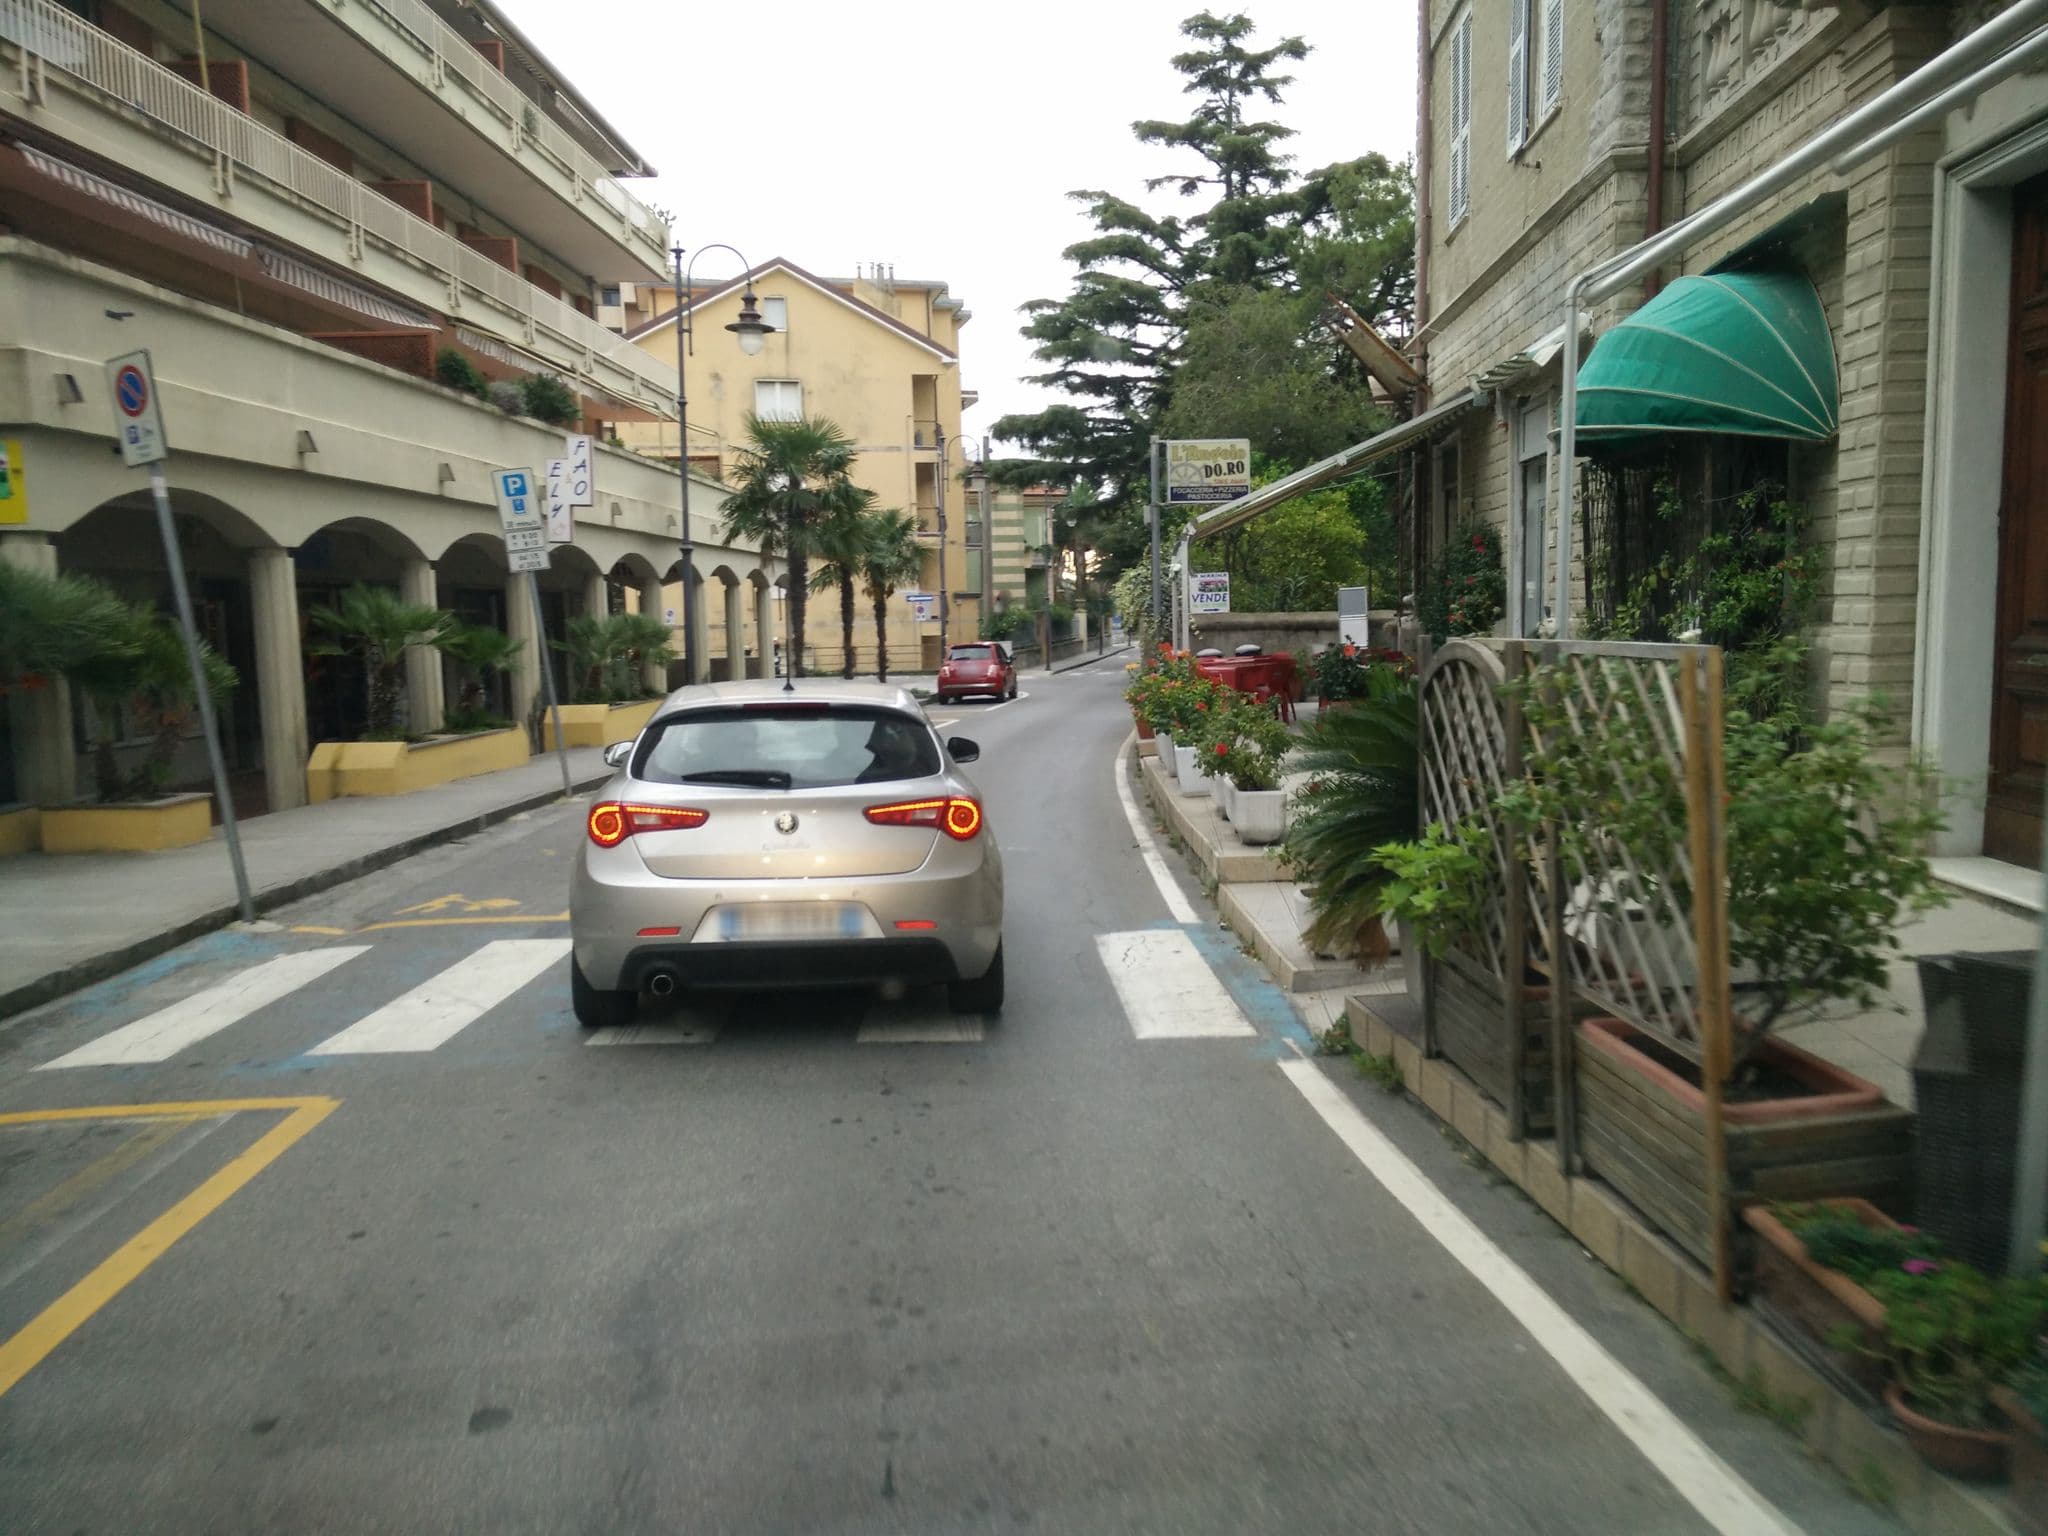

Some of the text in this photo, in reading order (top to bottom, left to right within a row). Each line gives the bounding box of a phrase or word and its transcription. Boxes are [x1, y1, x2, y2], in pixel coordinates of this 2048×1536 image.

[1204, 460, 1245, 478] DO.RO
[508, 477, 522, 495] P
[1192, 592, 1228, 603] VENDE
